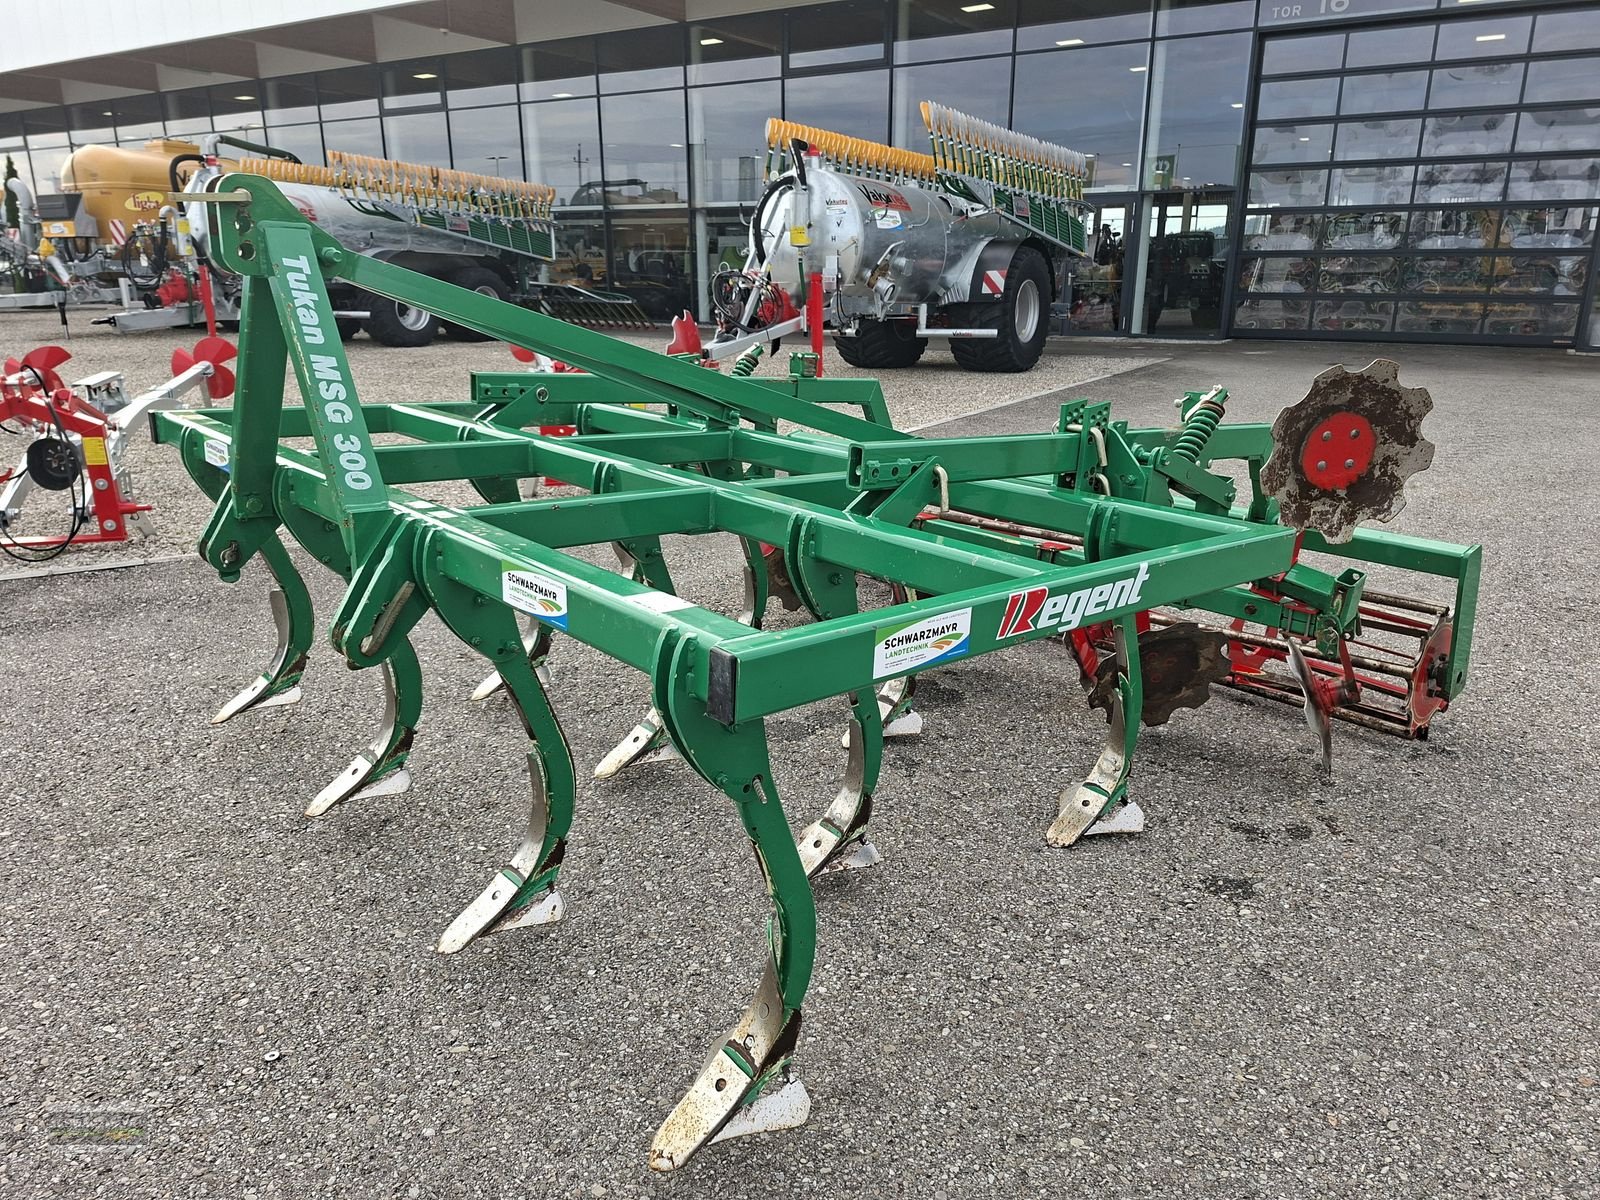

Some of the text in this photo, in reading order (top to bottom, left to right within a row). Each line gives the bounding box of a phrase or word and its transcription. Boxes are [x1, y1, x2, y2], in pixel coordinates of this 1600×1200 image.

[1272, 5, 1302, 18] TOR
[282, 255, 325, 344] Tukan
[309, 354, 353, 423] MSG
[334, 434, 372, 490] 300
[507, 572, 558, 601] SCHWARZMAYR
[996, 562, 1150, 640] Regent
[884, 622, 958, 650] SCHWARZMAYR
[885, 642, 929, 660] LANDTECHNIK
